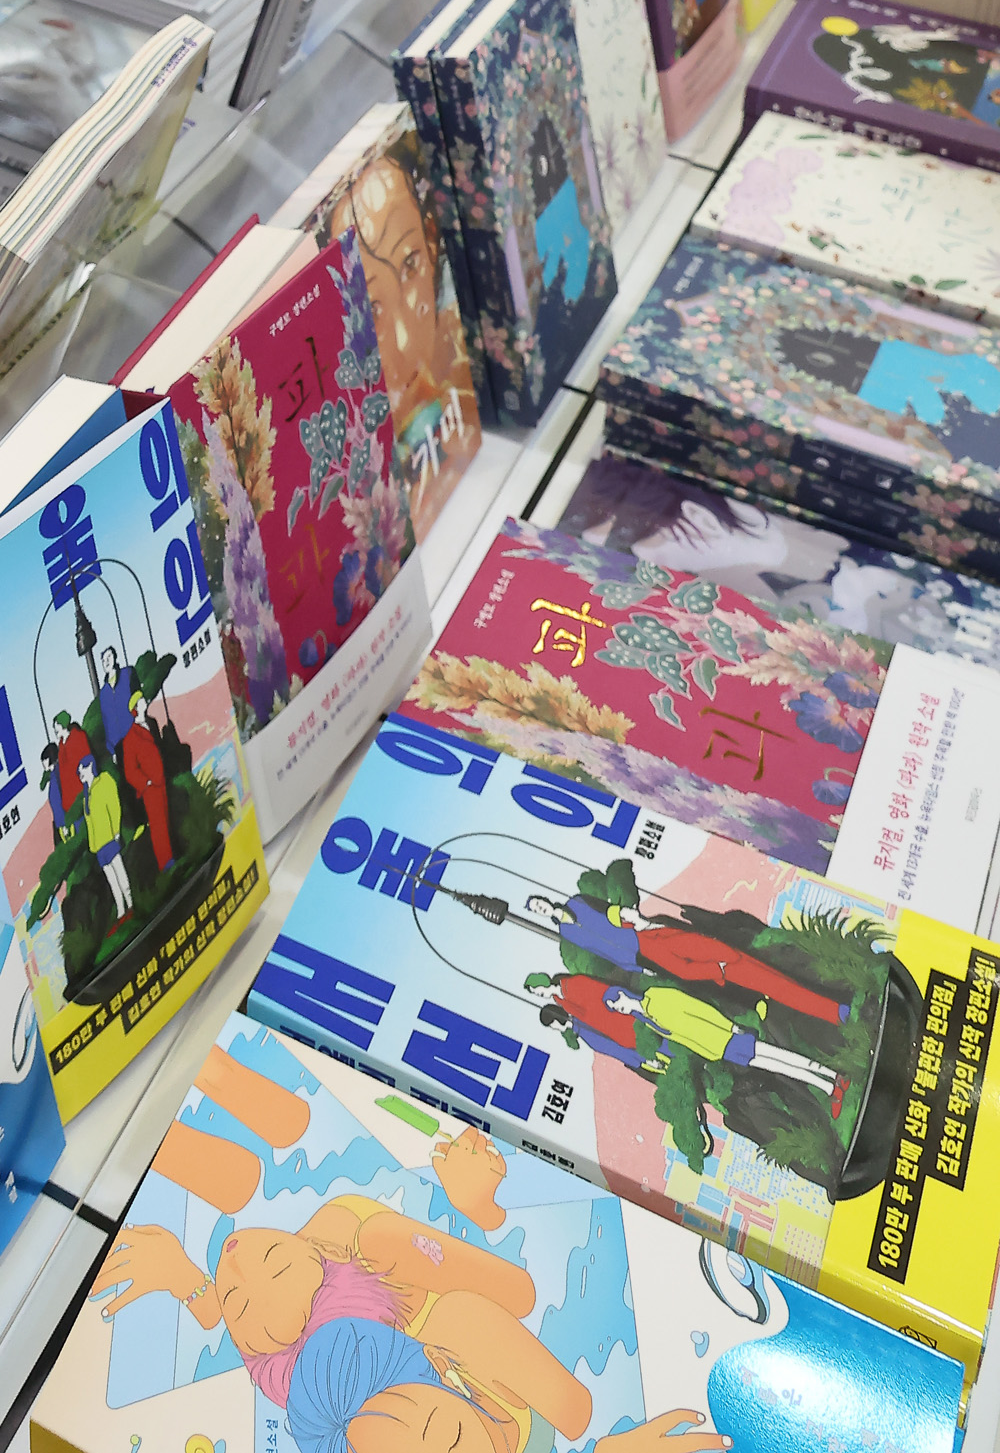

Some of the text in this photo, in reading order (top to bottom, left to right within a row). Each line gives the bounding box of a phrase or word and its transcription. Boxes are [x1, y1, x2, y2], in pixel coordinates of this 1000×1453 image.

[917, 692, 941, 722] 소설
[908, 720, 932, 749] 원작
[888, 792, 913, 820] 영화
[635, 819, 666, 862] 장편소설
[873, 826, 905, 872] 뮤지컬,
[127, 980, 161, 1025] 김호연
[162, 944, 195, 986] 작가의
[196, 919, 216, 951] 신작
[55, 1022, 93, 1065] 180만
[95, 1009, 108, 1027] 부
[109, 982, 134, 1014] 판매
[136, 957, 159, 989] 신화
[936, 957, 996, 1178] 김호연 작가의 신작 장편소설!
[541, 1079, 574, 1125] 김호연
[904, 1098, 931, 1139] 신화
[895, 1138, 923, 1182] 판매
[889, 1181, 914, 1204] 부
[878, 1205, 909, 1269] 180만
